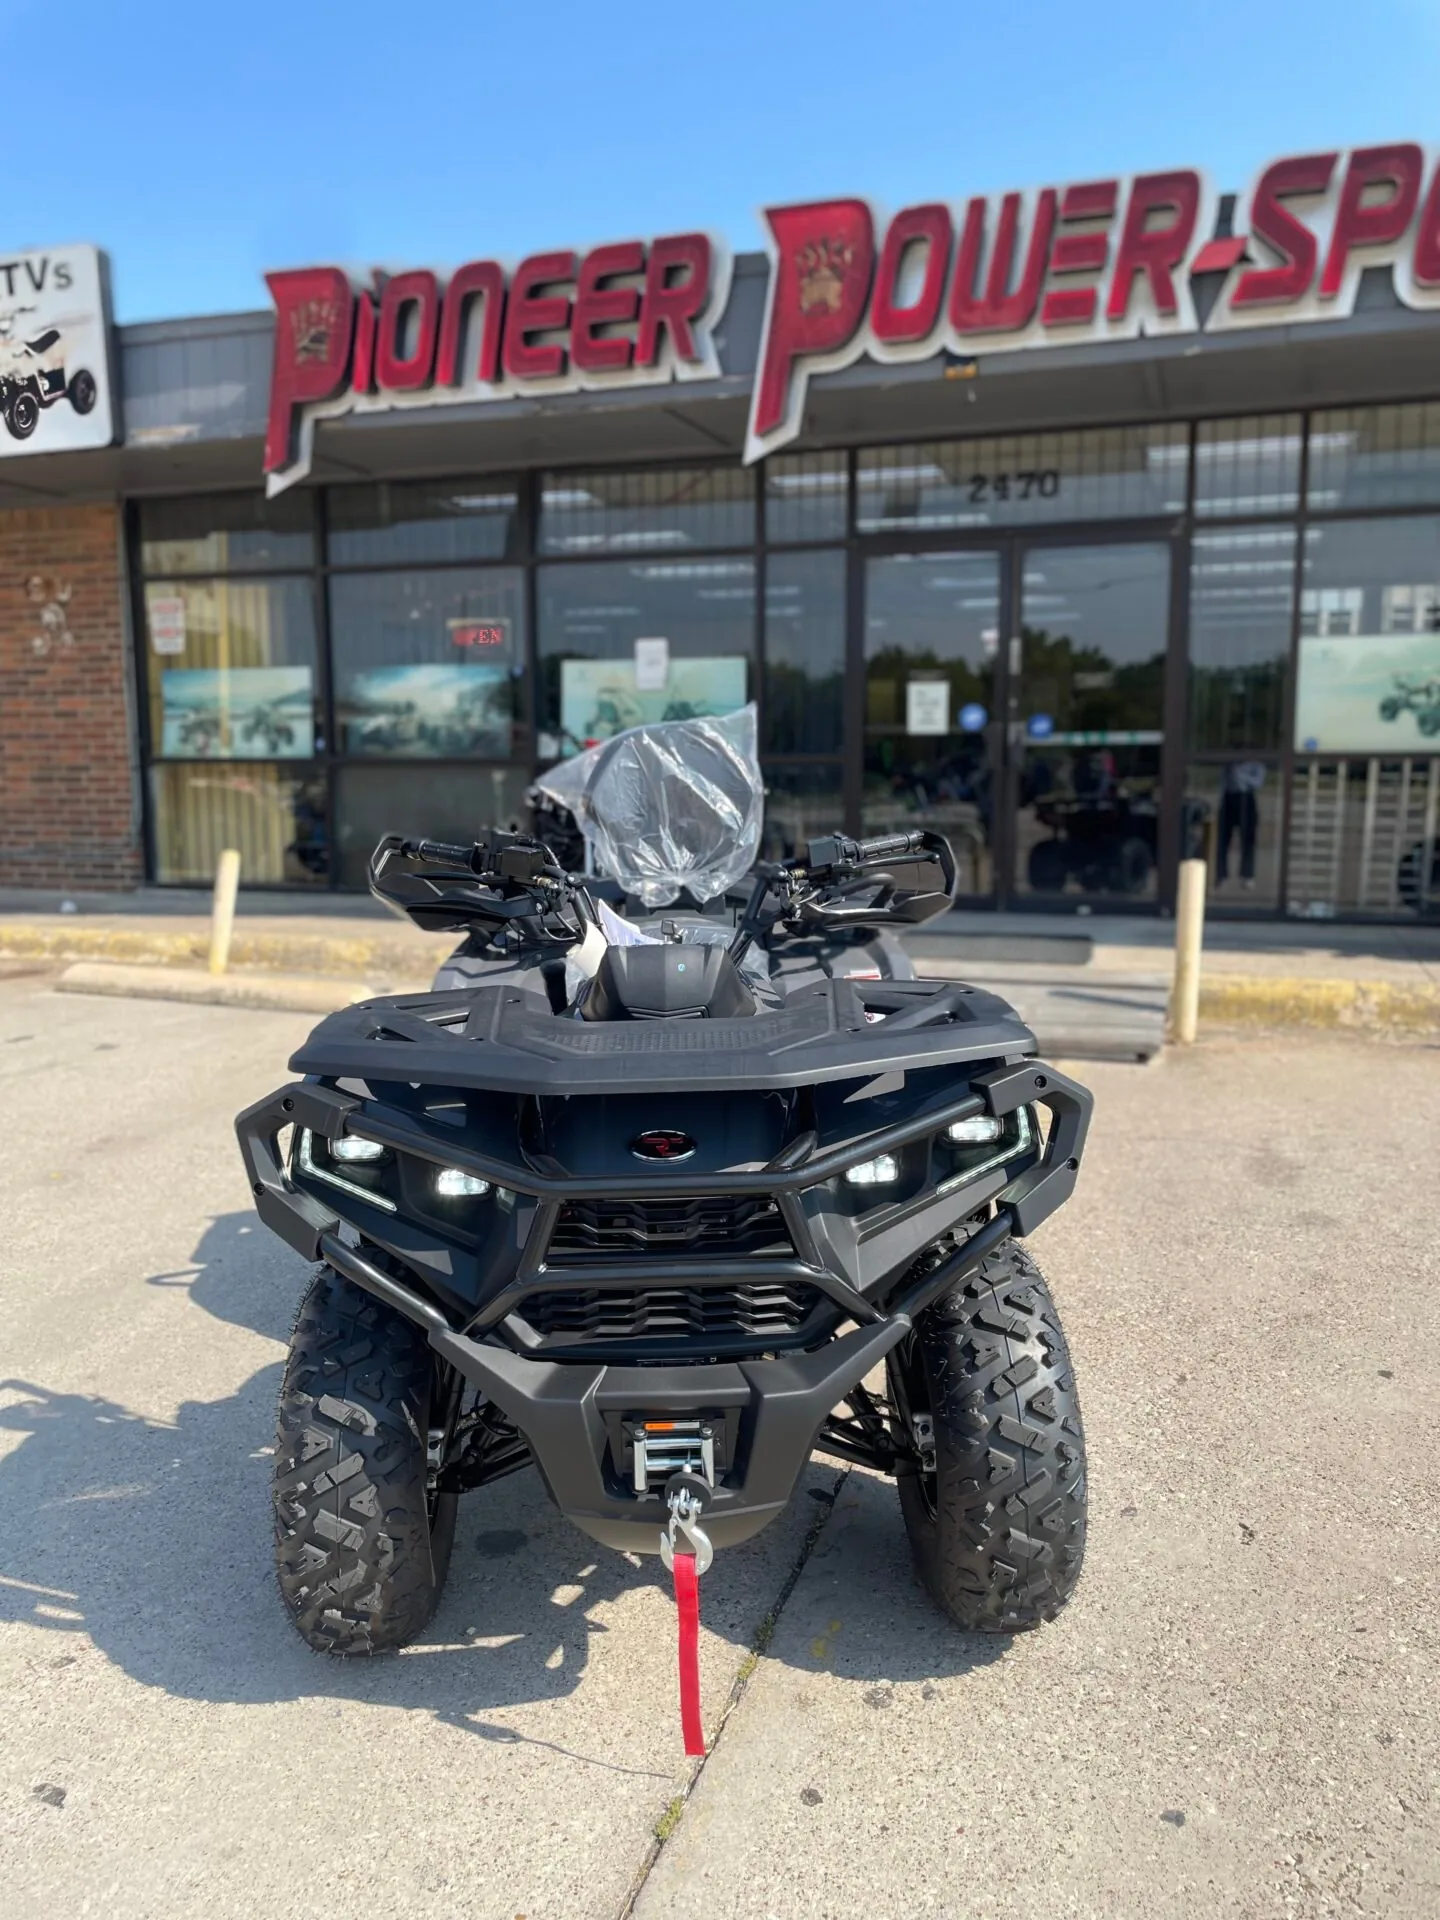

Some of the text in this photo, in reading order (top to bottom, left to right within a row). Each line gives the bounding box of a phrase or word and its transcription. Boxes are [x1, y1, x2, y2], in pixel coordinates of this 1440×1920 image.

[264, 233, 711, 474] PIONEER
[968, 469, 1060, 503] 2470
[452, 627, 503, 645] EN
